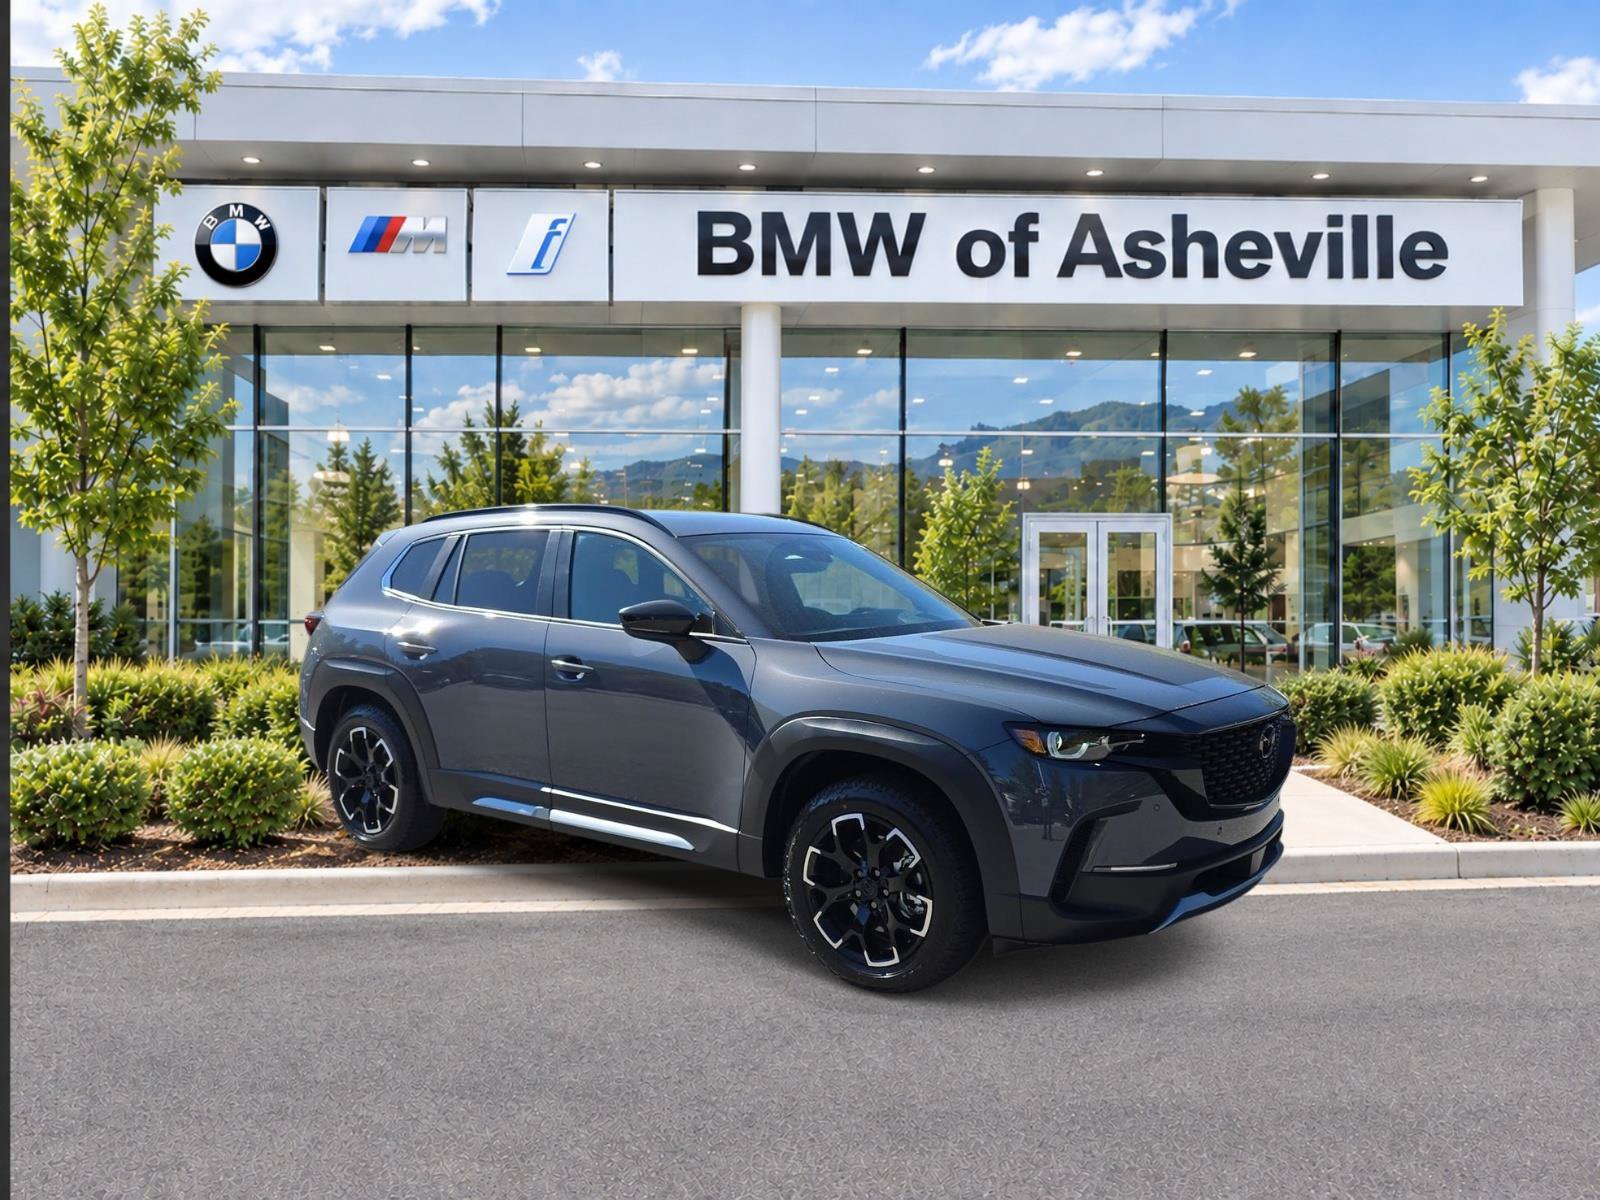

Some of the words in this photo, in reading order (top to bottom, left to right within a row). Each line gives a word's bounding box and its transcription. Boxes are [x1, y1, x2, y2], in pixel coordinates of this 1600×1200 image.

[203, 204, 271, 230] BMW
[389, 216, 448, 254] M
[697, 210, 927, 277] BMW
[956, 212, 1040, 279] of
[1056, 213, 1449, 281] Asheville
